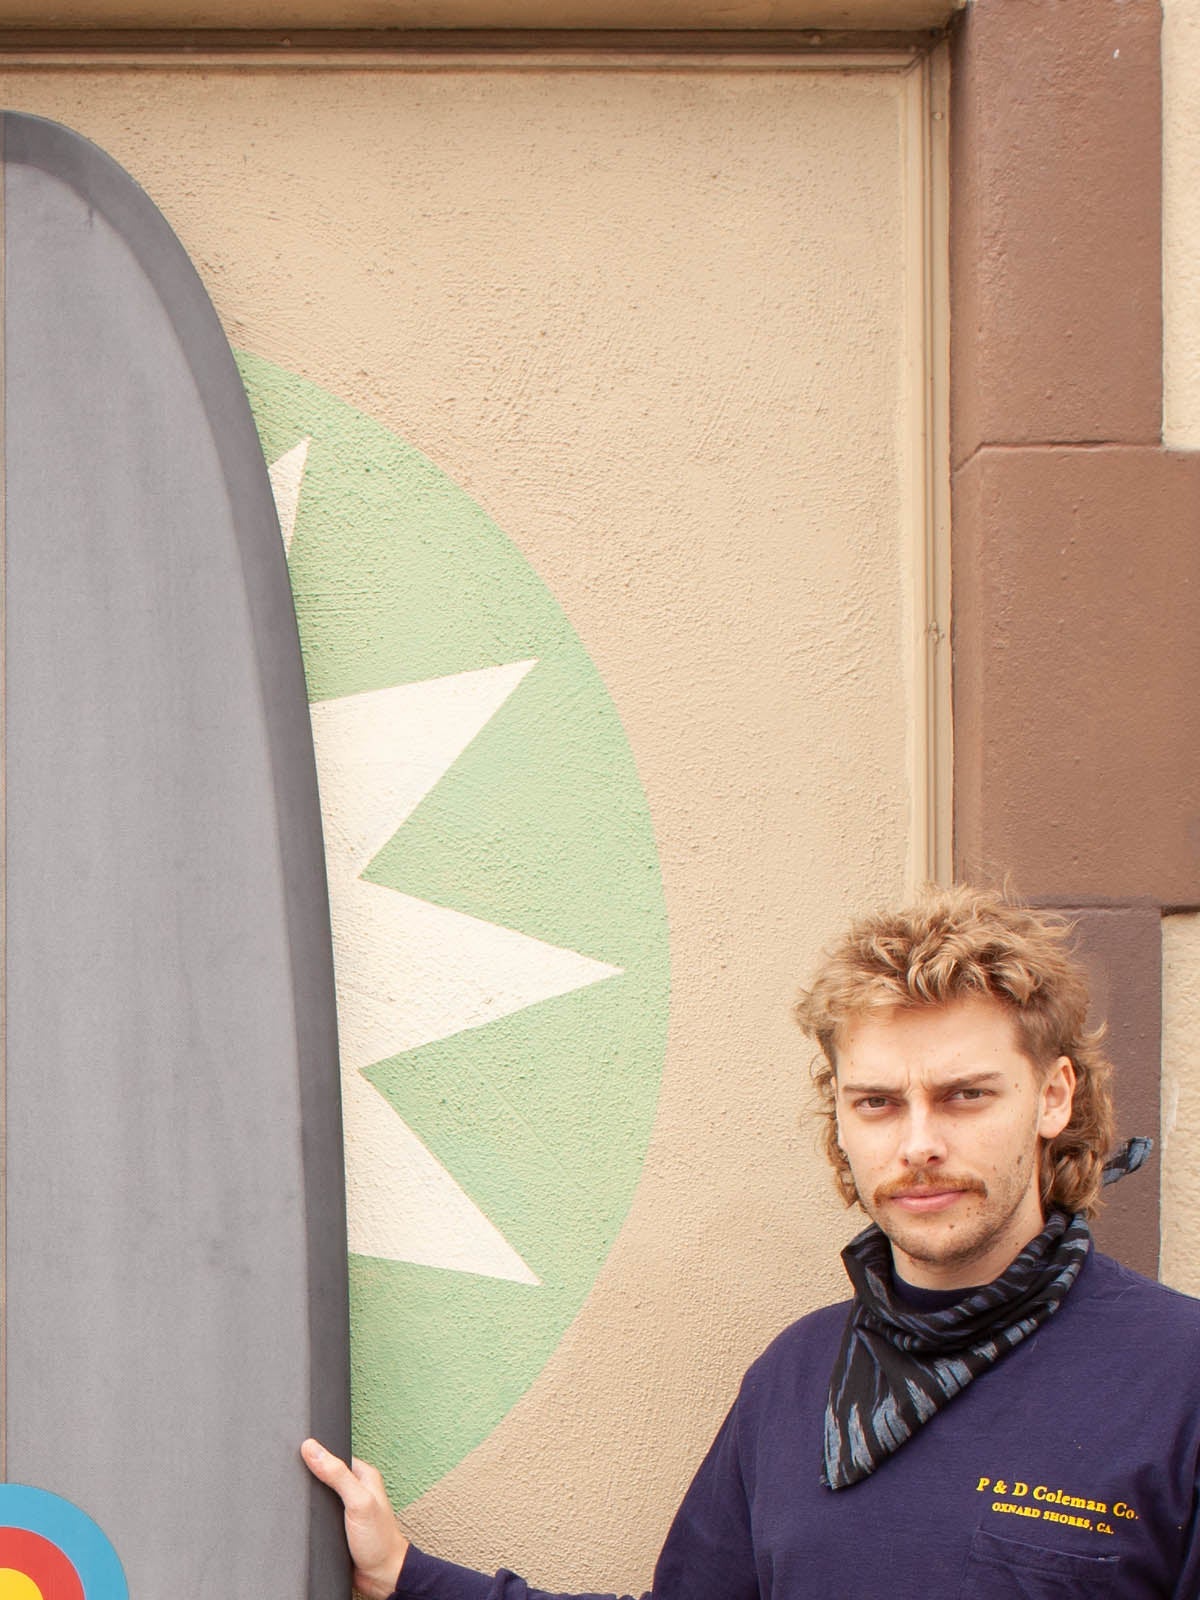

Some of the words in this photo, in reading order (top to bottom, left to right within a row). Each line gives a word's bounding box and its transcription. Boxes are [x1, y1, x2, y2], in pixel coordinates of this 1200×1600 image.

[976, 1477, 991, 1492] P
[992, 1480, 1008, 1495] &
[1012, 1482, 1029, 1497] D
[1032, 1485, 1108, 1514] Coleman
[1112, 1502, 1139, 1520] Co.
[992, 1502, 1041, 1519] OXNARD
[1042, 1510, 1093, 1531] SHORES,
[1095, 1522, 1115, 1536] CA.
